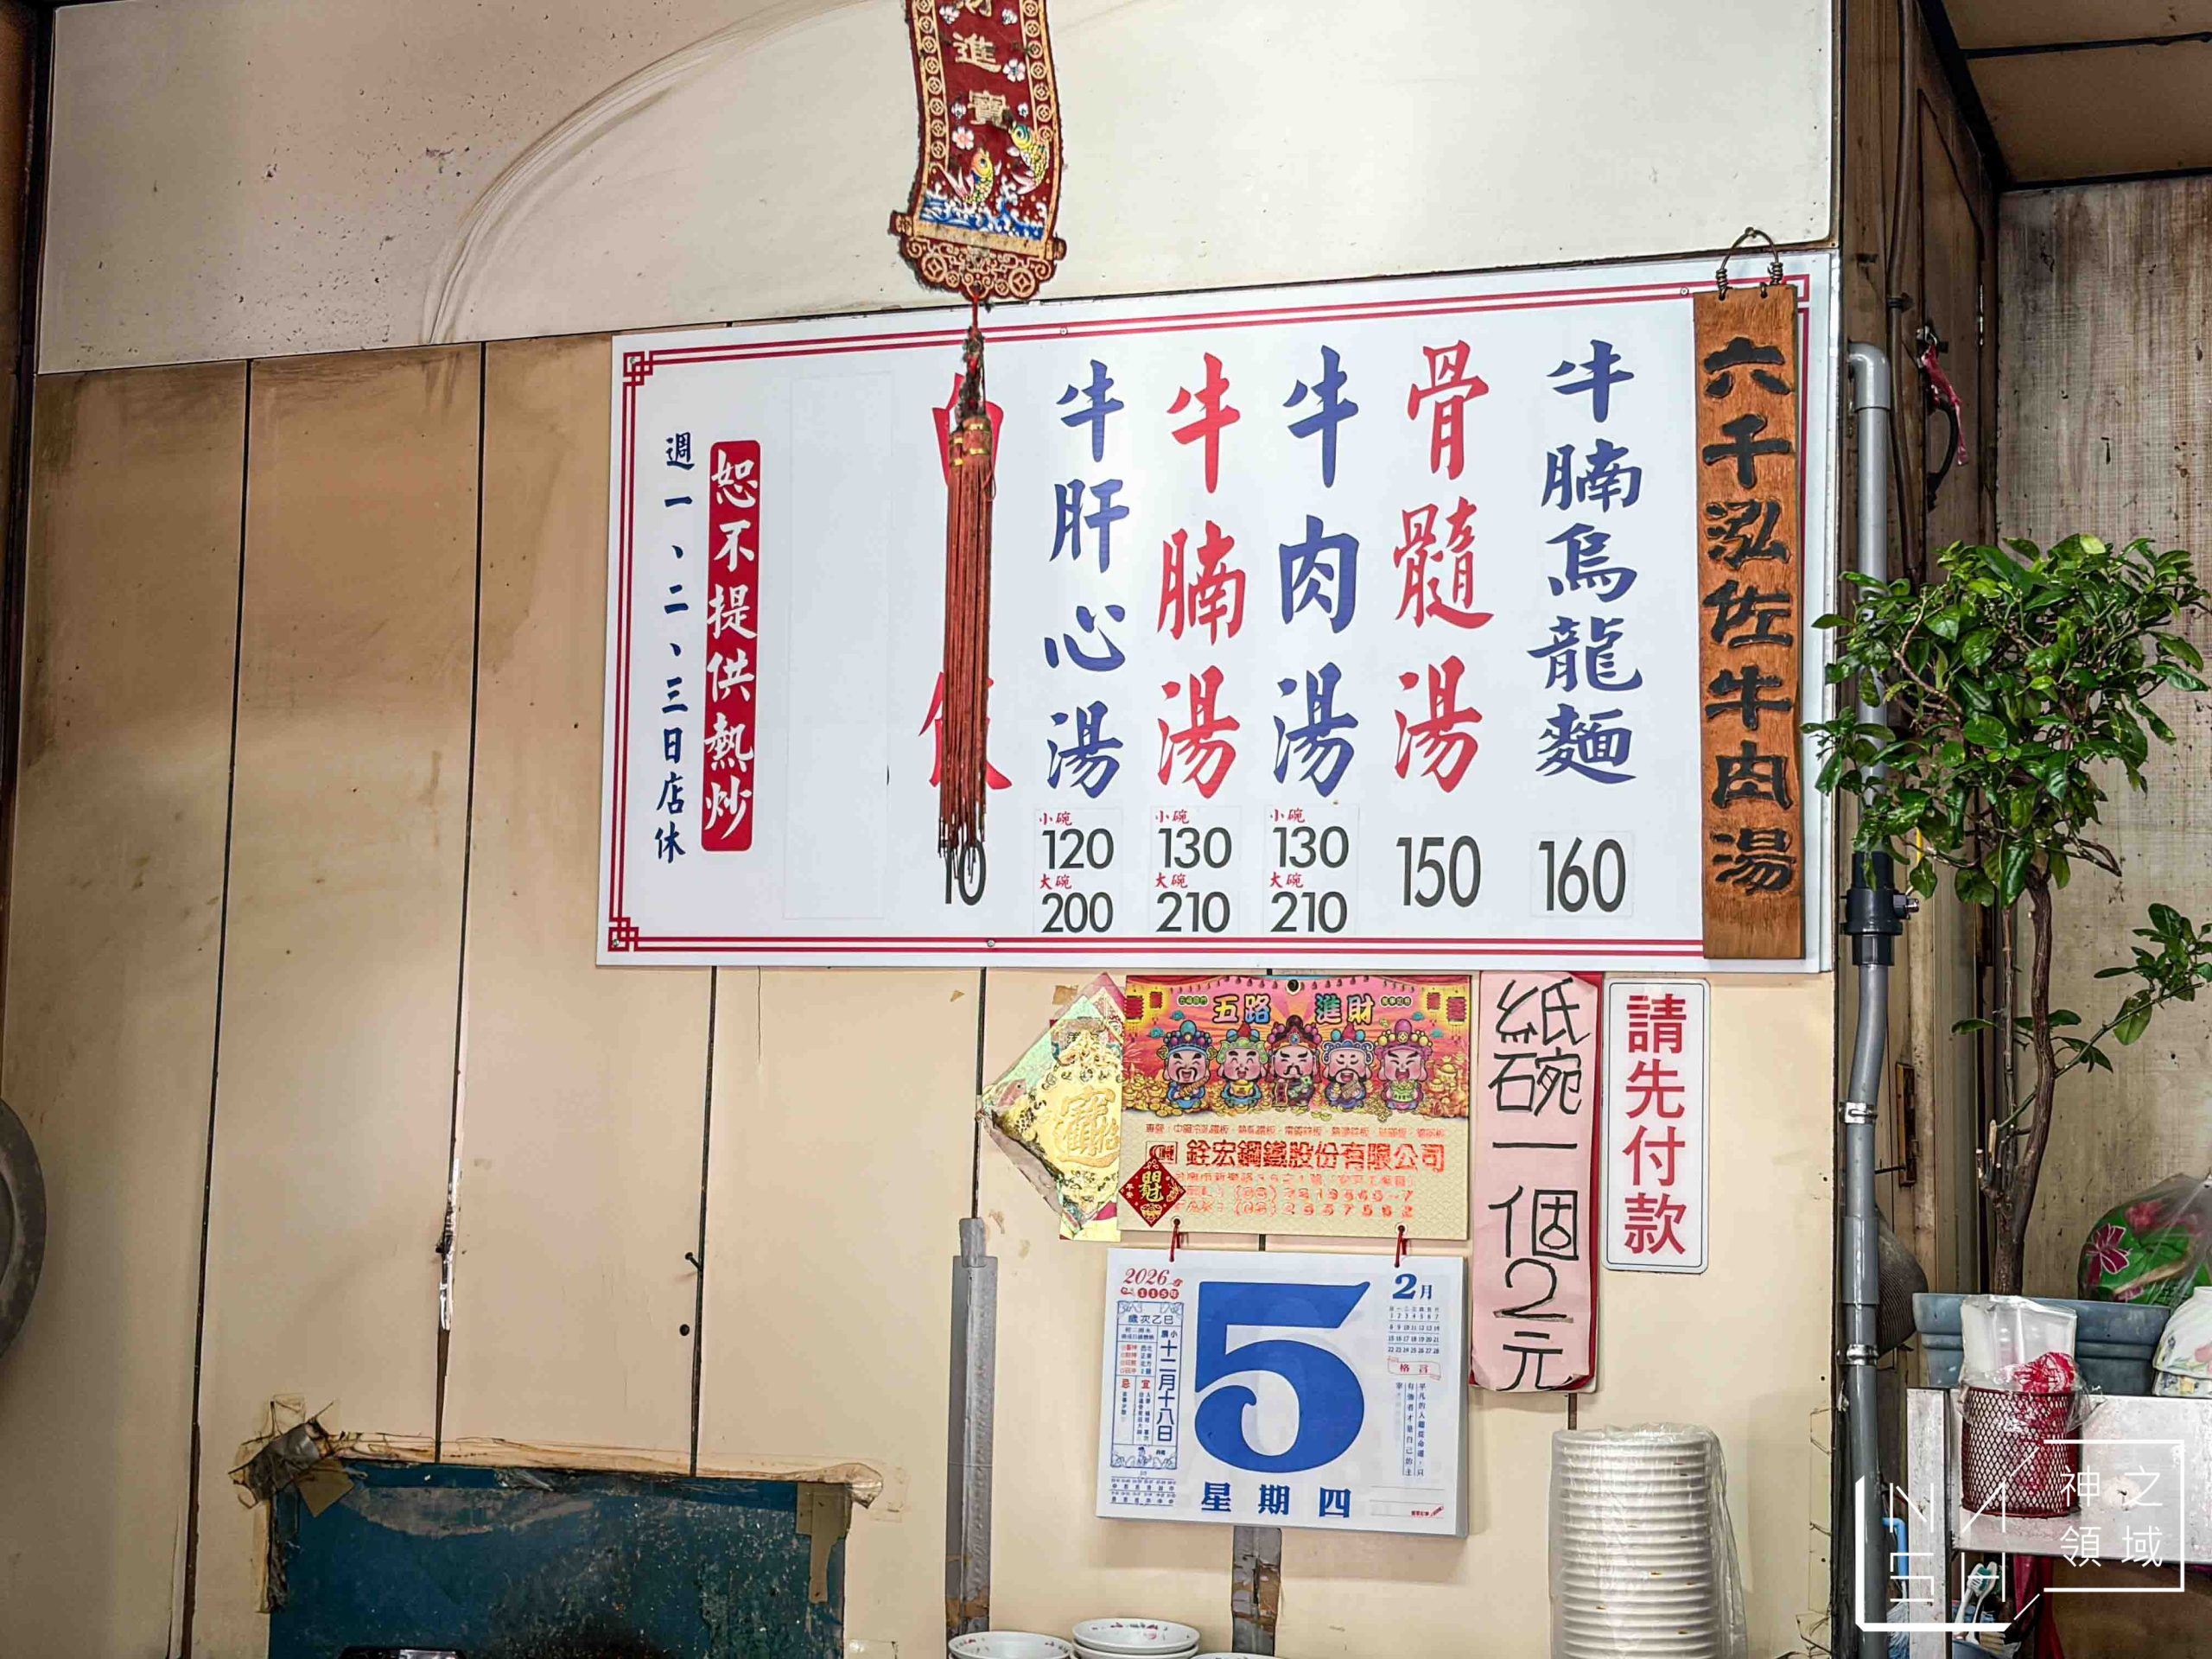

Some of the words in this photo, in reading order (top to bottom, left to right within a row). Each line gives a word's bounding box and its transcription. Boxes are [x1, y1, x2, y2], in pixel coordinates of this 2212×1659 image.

[1044, 359, 1129, 798] 牛肝心湯
[1158, 353, 1245, 798] 牛腩湯
[1274, 345, 1359, 798] 牛肉湯
[1393, 340, 1493, 793] 骨髓湯
[1529, 340, 1643, 784] 牛腩烏龍麵
[1703, 337, 1796, 895] 六千泓佐牛肉湯
[704, 449, 757, 842] 恕不提供熱炒
[1039, 810, 1072, 826] 小碗
[1155, 809, 1189, 824] 小碗
[1270, 808, 1306, 823] 小碗
[1042, 828, 1114, 869] 120
[1158, 827, 1232, 869] 130
[1273, 826, 1349, 868] 130
[1039, 874, 1072, 890] 大碗
[1155, 872, 1188, 888] 大碗
[1270, 872, 1303, 888] 大碗
[1395, 836, 1481, 907] 150
[1538, 836, 1626, 912] 160
[1041, 892, 1113, 933] 200
[1156, 891, 1230, 933] 210
[1270, 891, 1348, 933] 210
[1212, 994, 1271, 1024] 五路
[1314, 994, 1374, 1026] 進財
[1623, 993, 1688, 1255] 請先付款
[1488, 977, 1591, 1391] 紙碗一個2元
[1123, 1268, 1170, 1286] 2026
[1392, 1273, 1433, 1300] 2月
[1156, 1339, 1178, 1442] 十二月十八日
[1194, 1281, 1371, 1474] 5
[1201, 1482, 1351, 1519] 星期四
